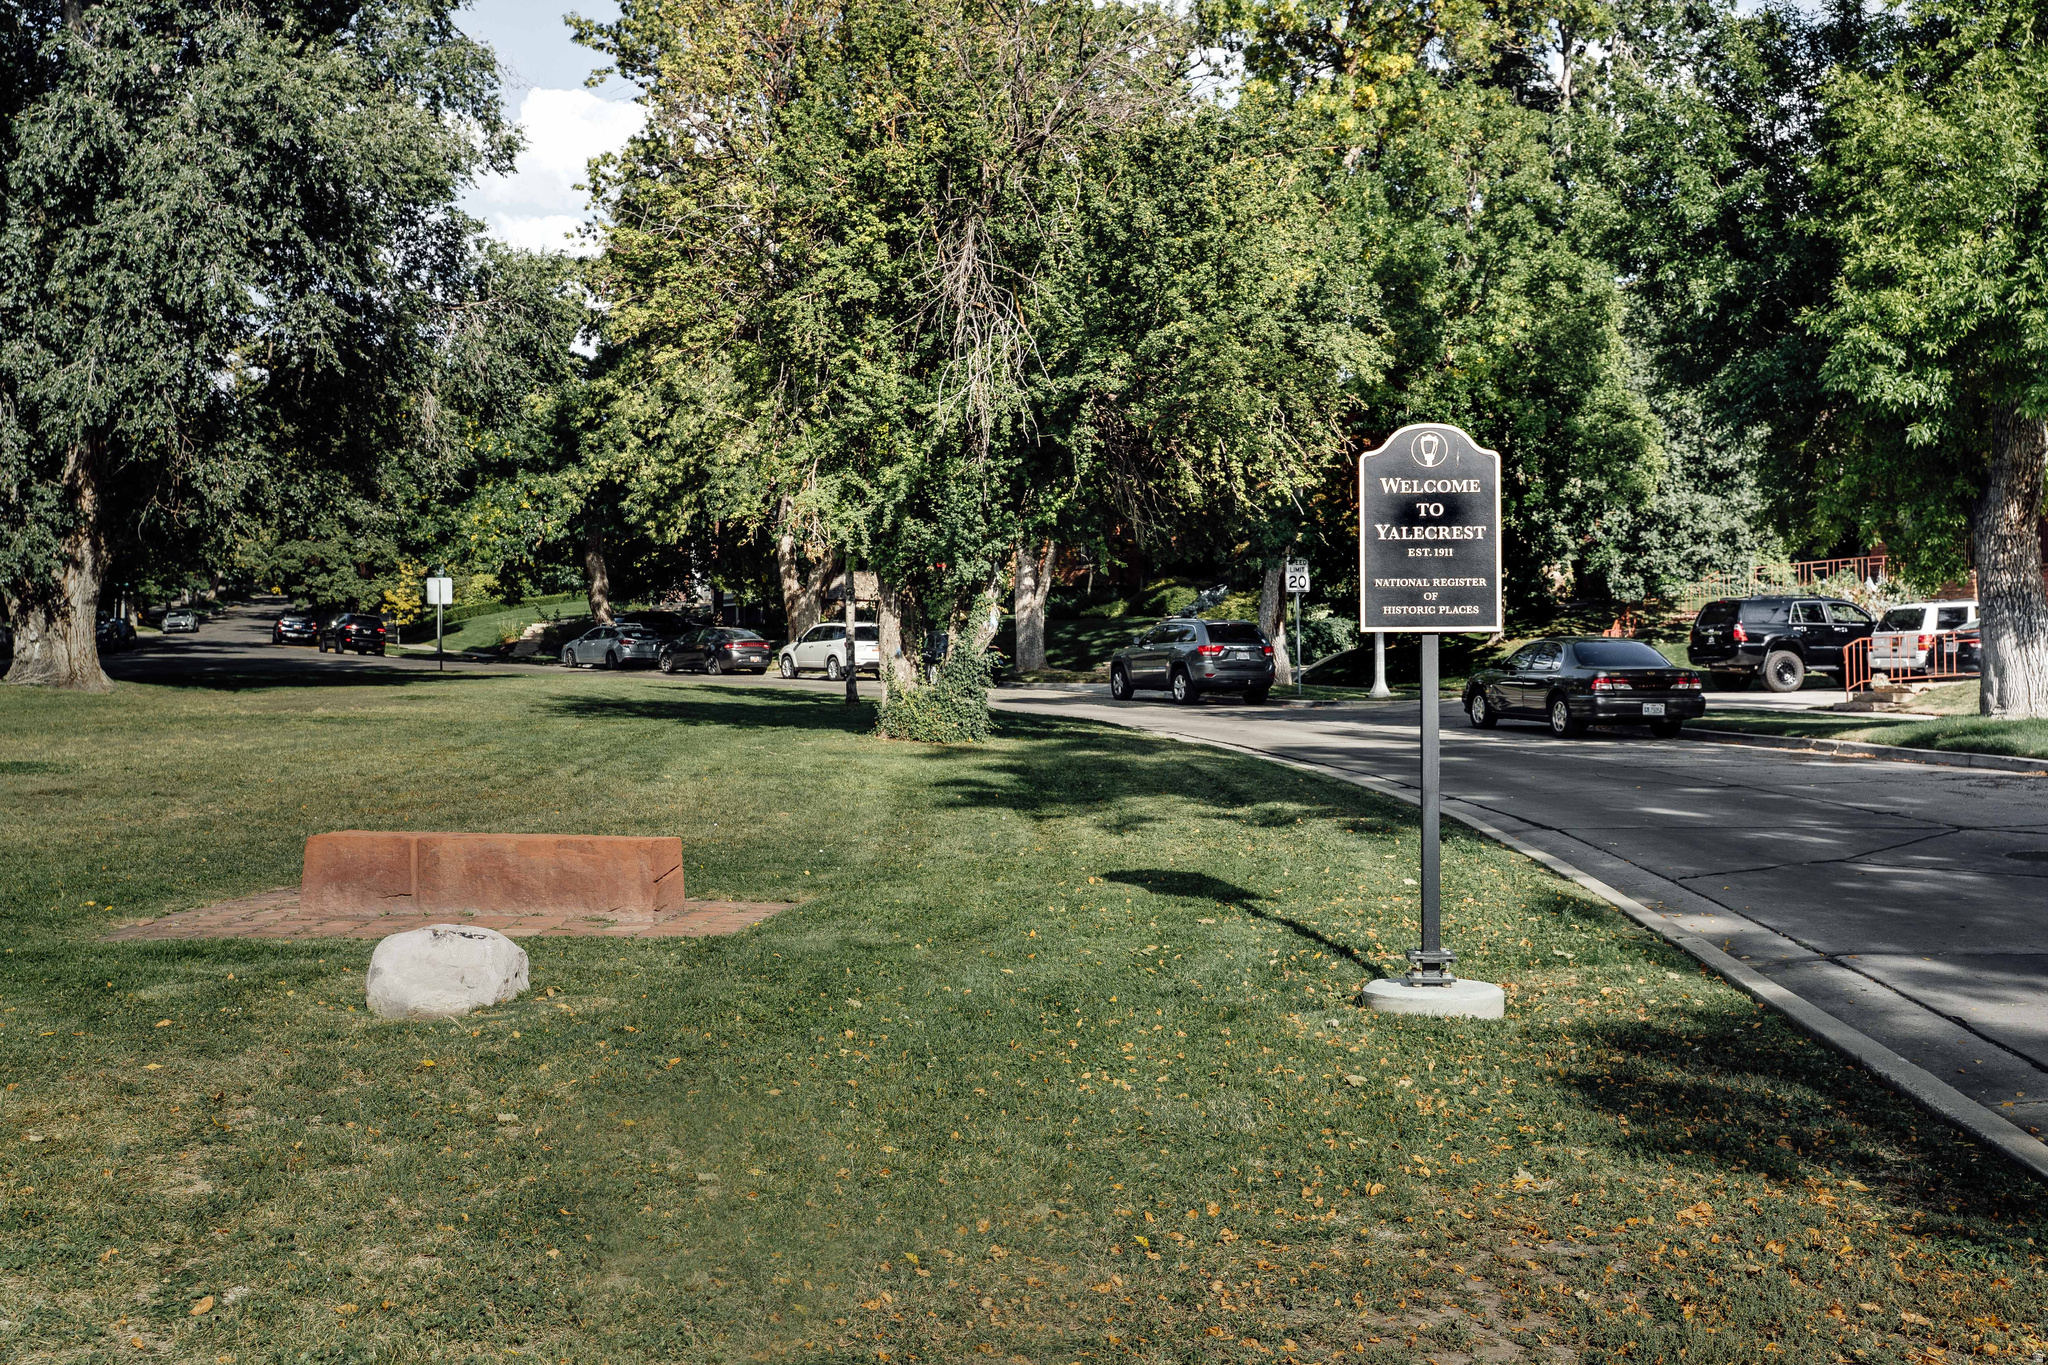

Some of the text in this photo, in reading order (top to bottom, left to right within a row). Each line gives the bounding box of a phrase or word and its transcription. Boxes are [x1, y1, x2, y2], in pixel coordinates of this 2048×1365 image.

[1380, 478, 1480, 493] WELCOME
[1416, 503, 1444, 516] TO
[1375, 524, 1486, 539] YALECREST
[1408, 548, 1453, 557] EST. 1911
[1289, 575, 1306, 588] 20
[1375, 578, 1487, 587] NATIONAL REGISTER
[1423, 592, 1438, 601] OF
[1383, 606, 1479, 615] HISTORIC PLACES
